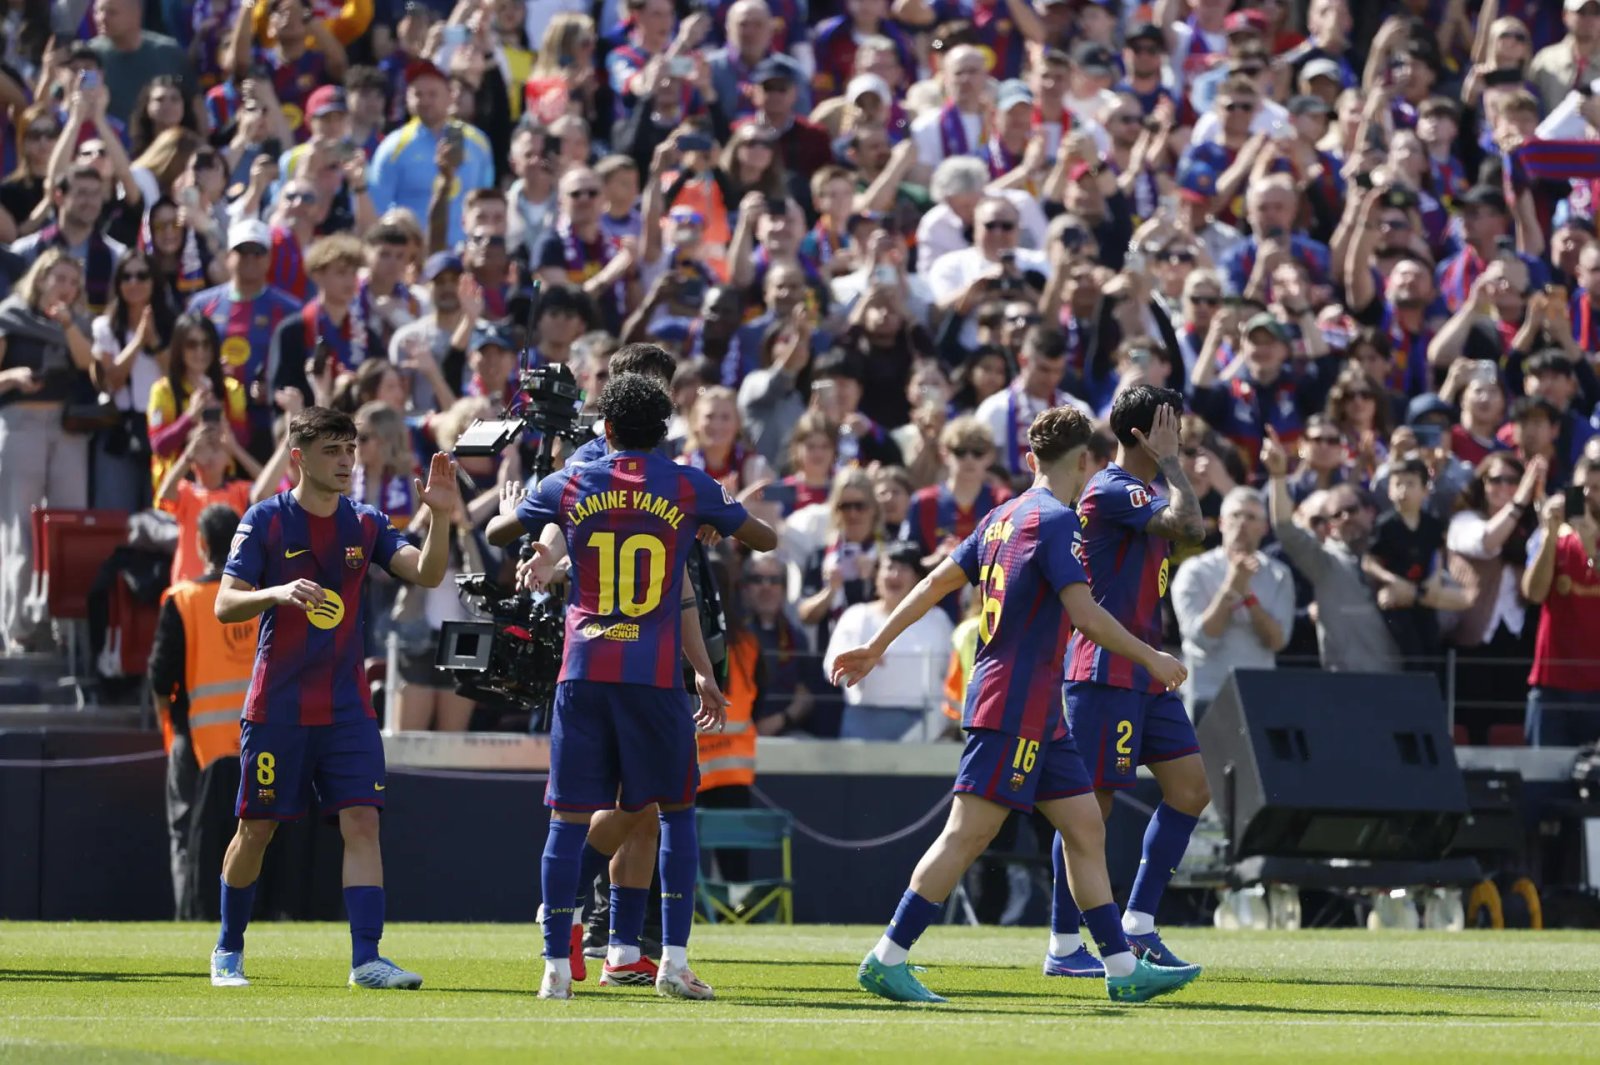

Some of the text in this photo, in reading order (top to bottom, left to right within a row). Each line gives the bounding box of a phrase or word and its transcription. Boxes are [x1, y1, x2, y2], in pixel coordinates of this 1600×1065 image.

[567, 490, 685, 530] LAMINE YAMAL
[587, 532, 666, 617] 10
[1012, 736, 1039, 773] 16
[1116, 720, 1133, 754] 2
[257, 752, 275, 785] 8
